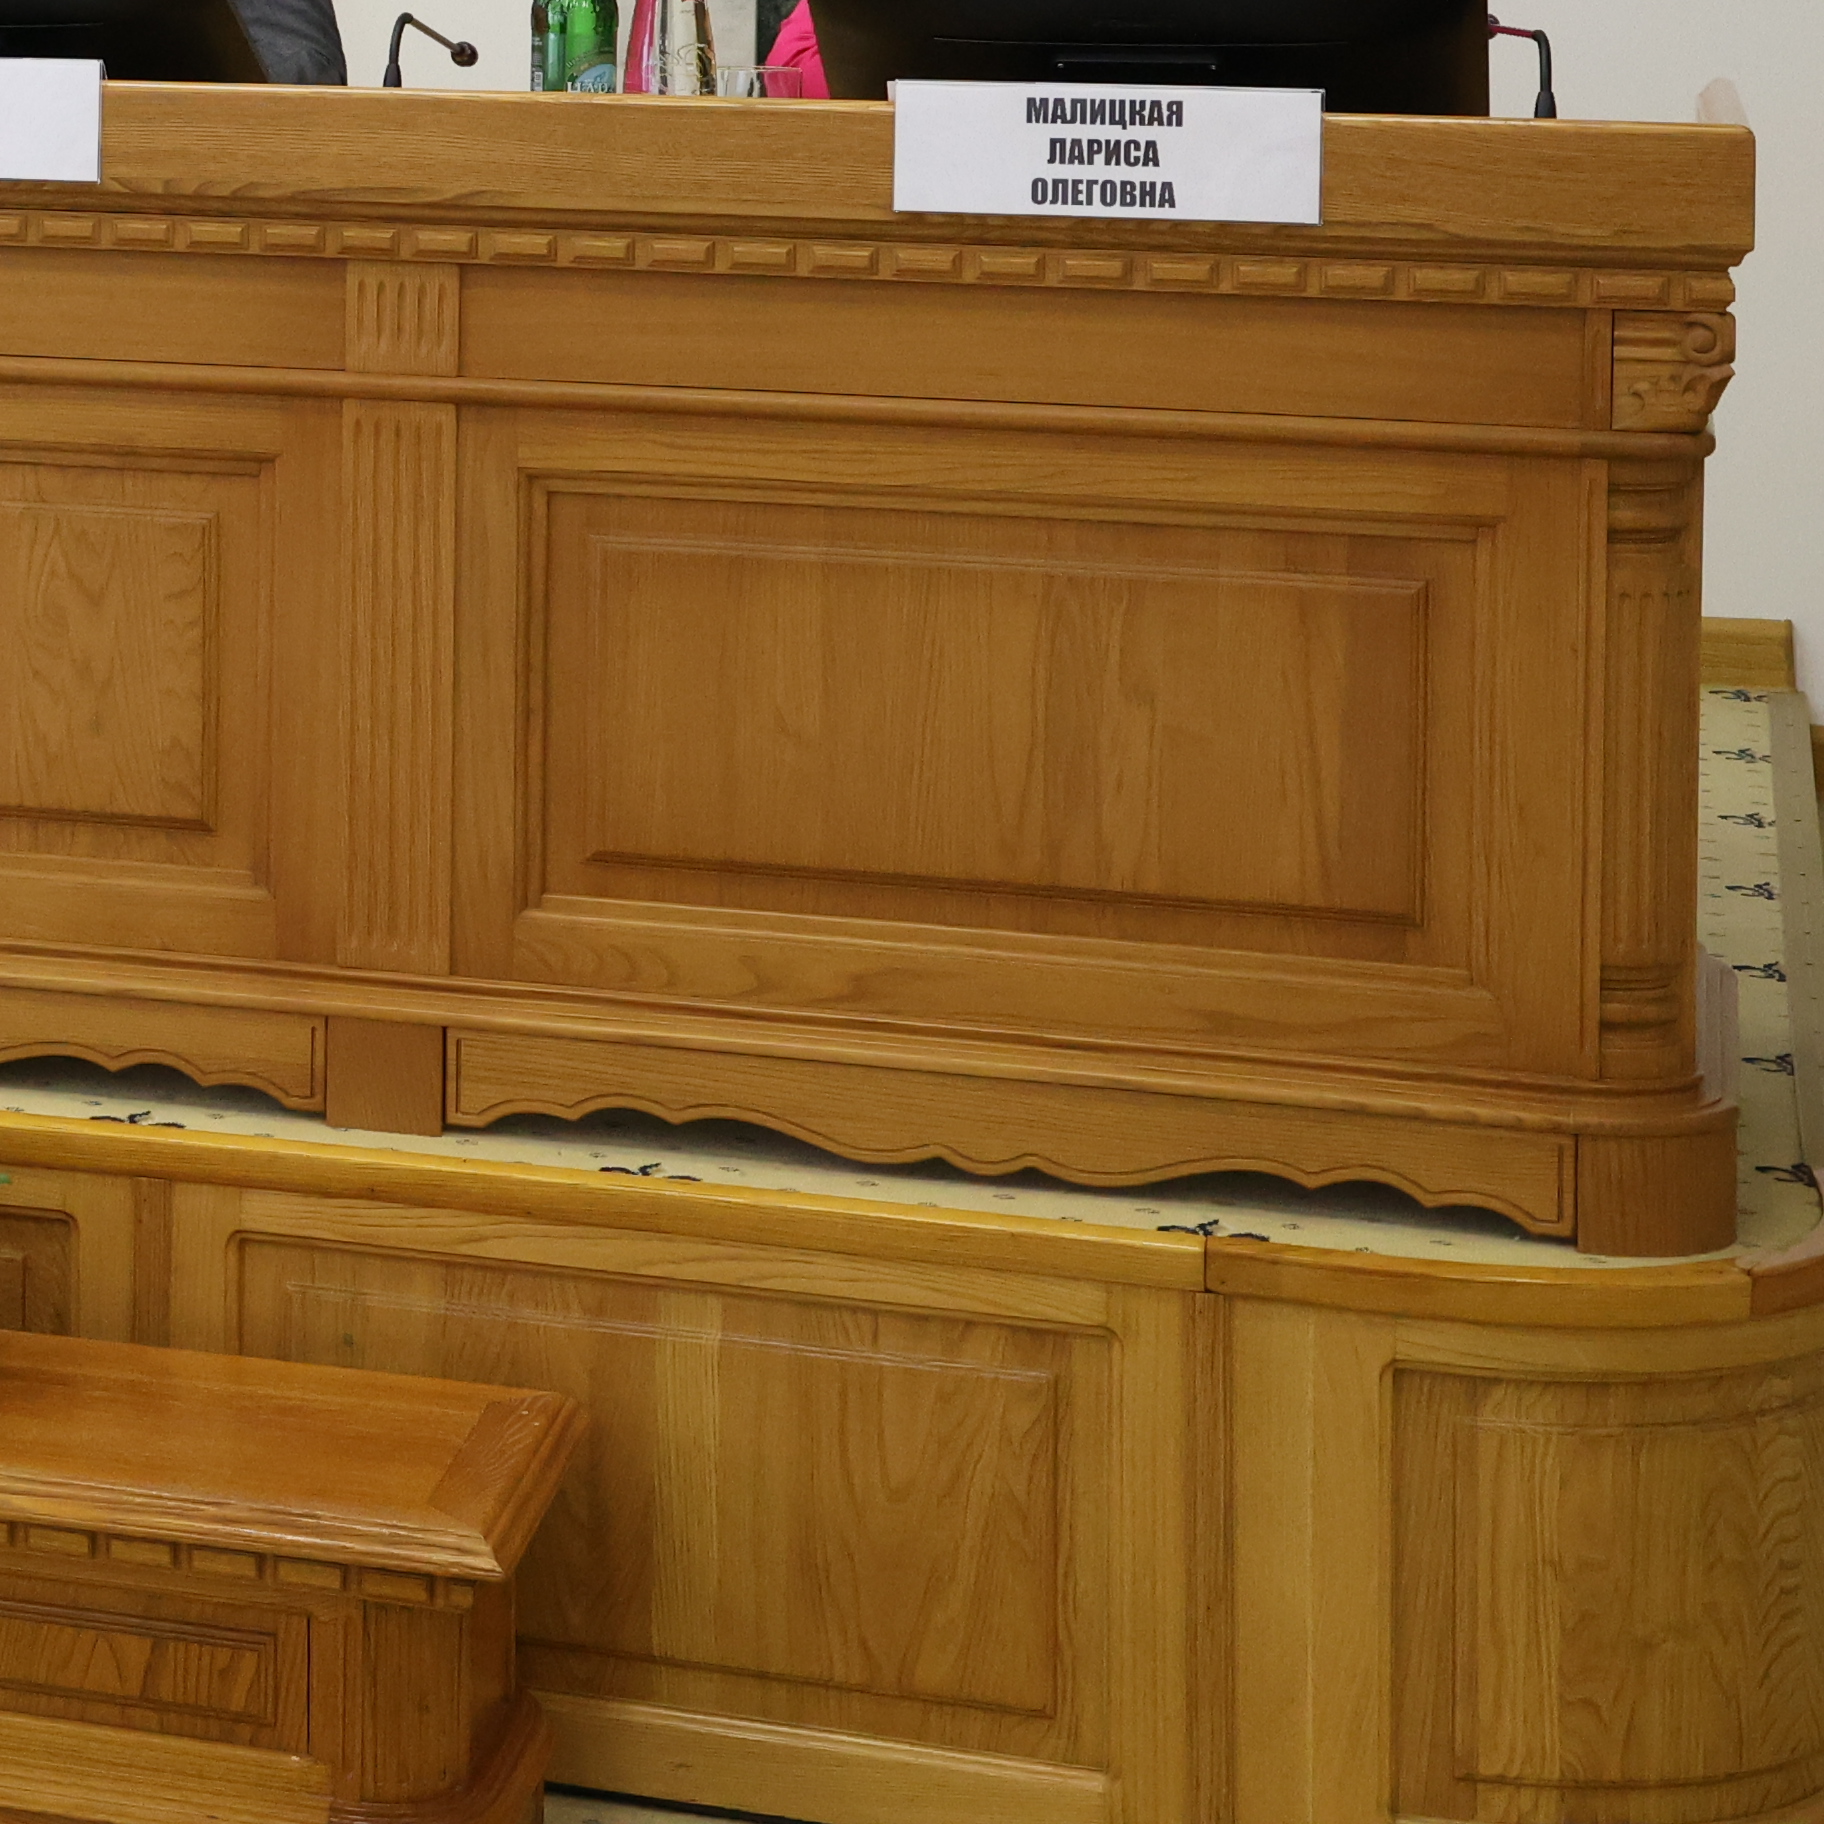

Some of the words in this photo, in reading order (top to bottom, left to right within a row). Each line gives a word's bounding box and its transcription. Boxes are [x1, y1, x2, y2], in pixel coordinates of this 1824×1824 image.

[1025, 96, 1184, 131] МАЛИЦКАЯ
[1046, 137, 1161, 168] ЛАРИСА
[1030, 177, 1177, 209] ОЛЕГОВНА
